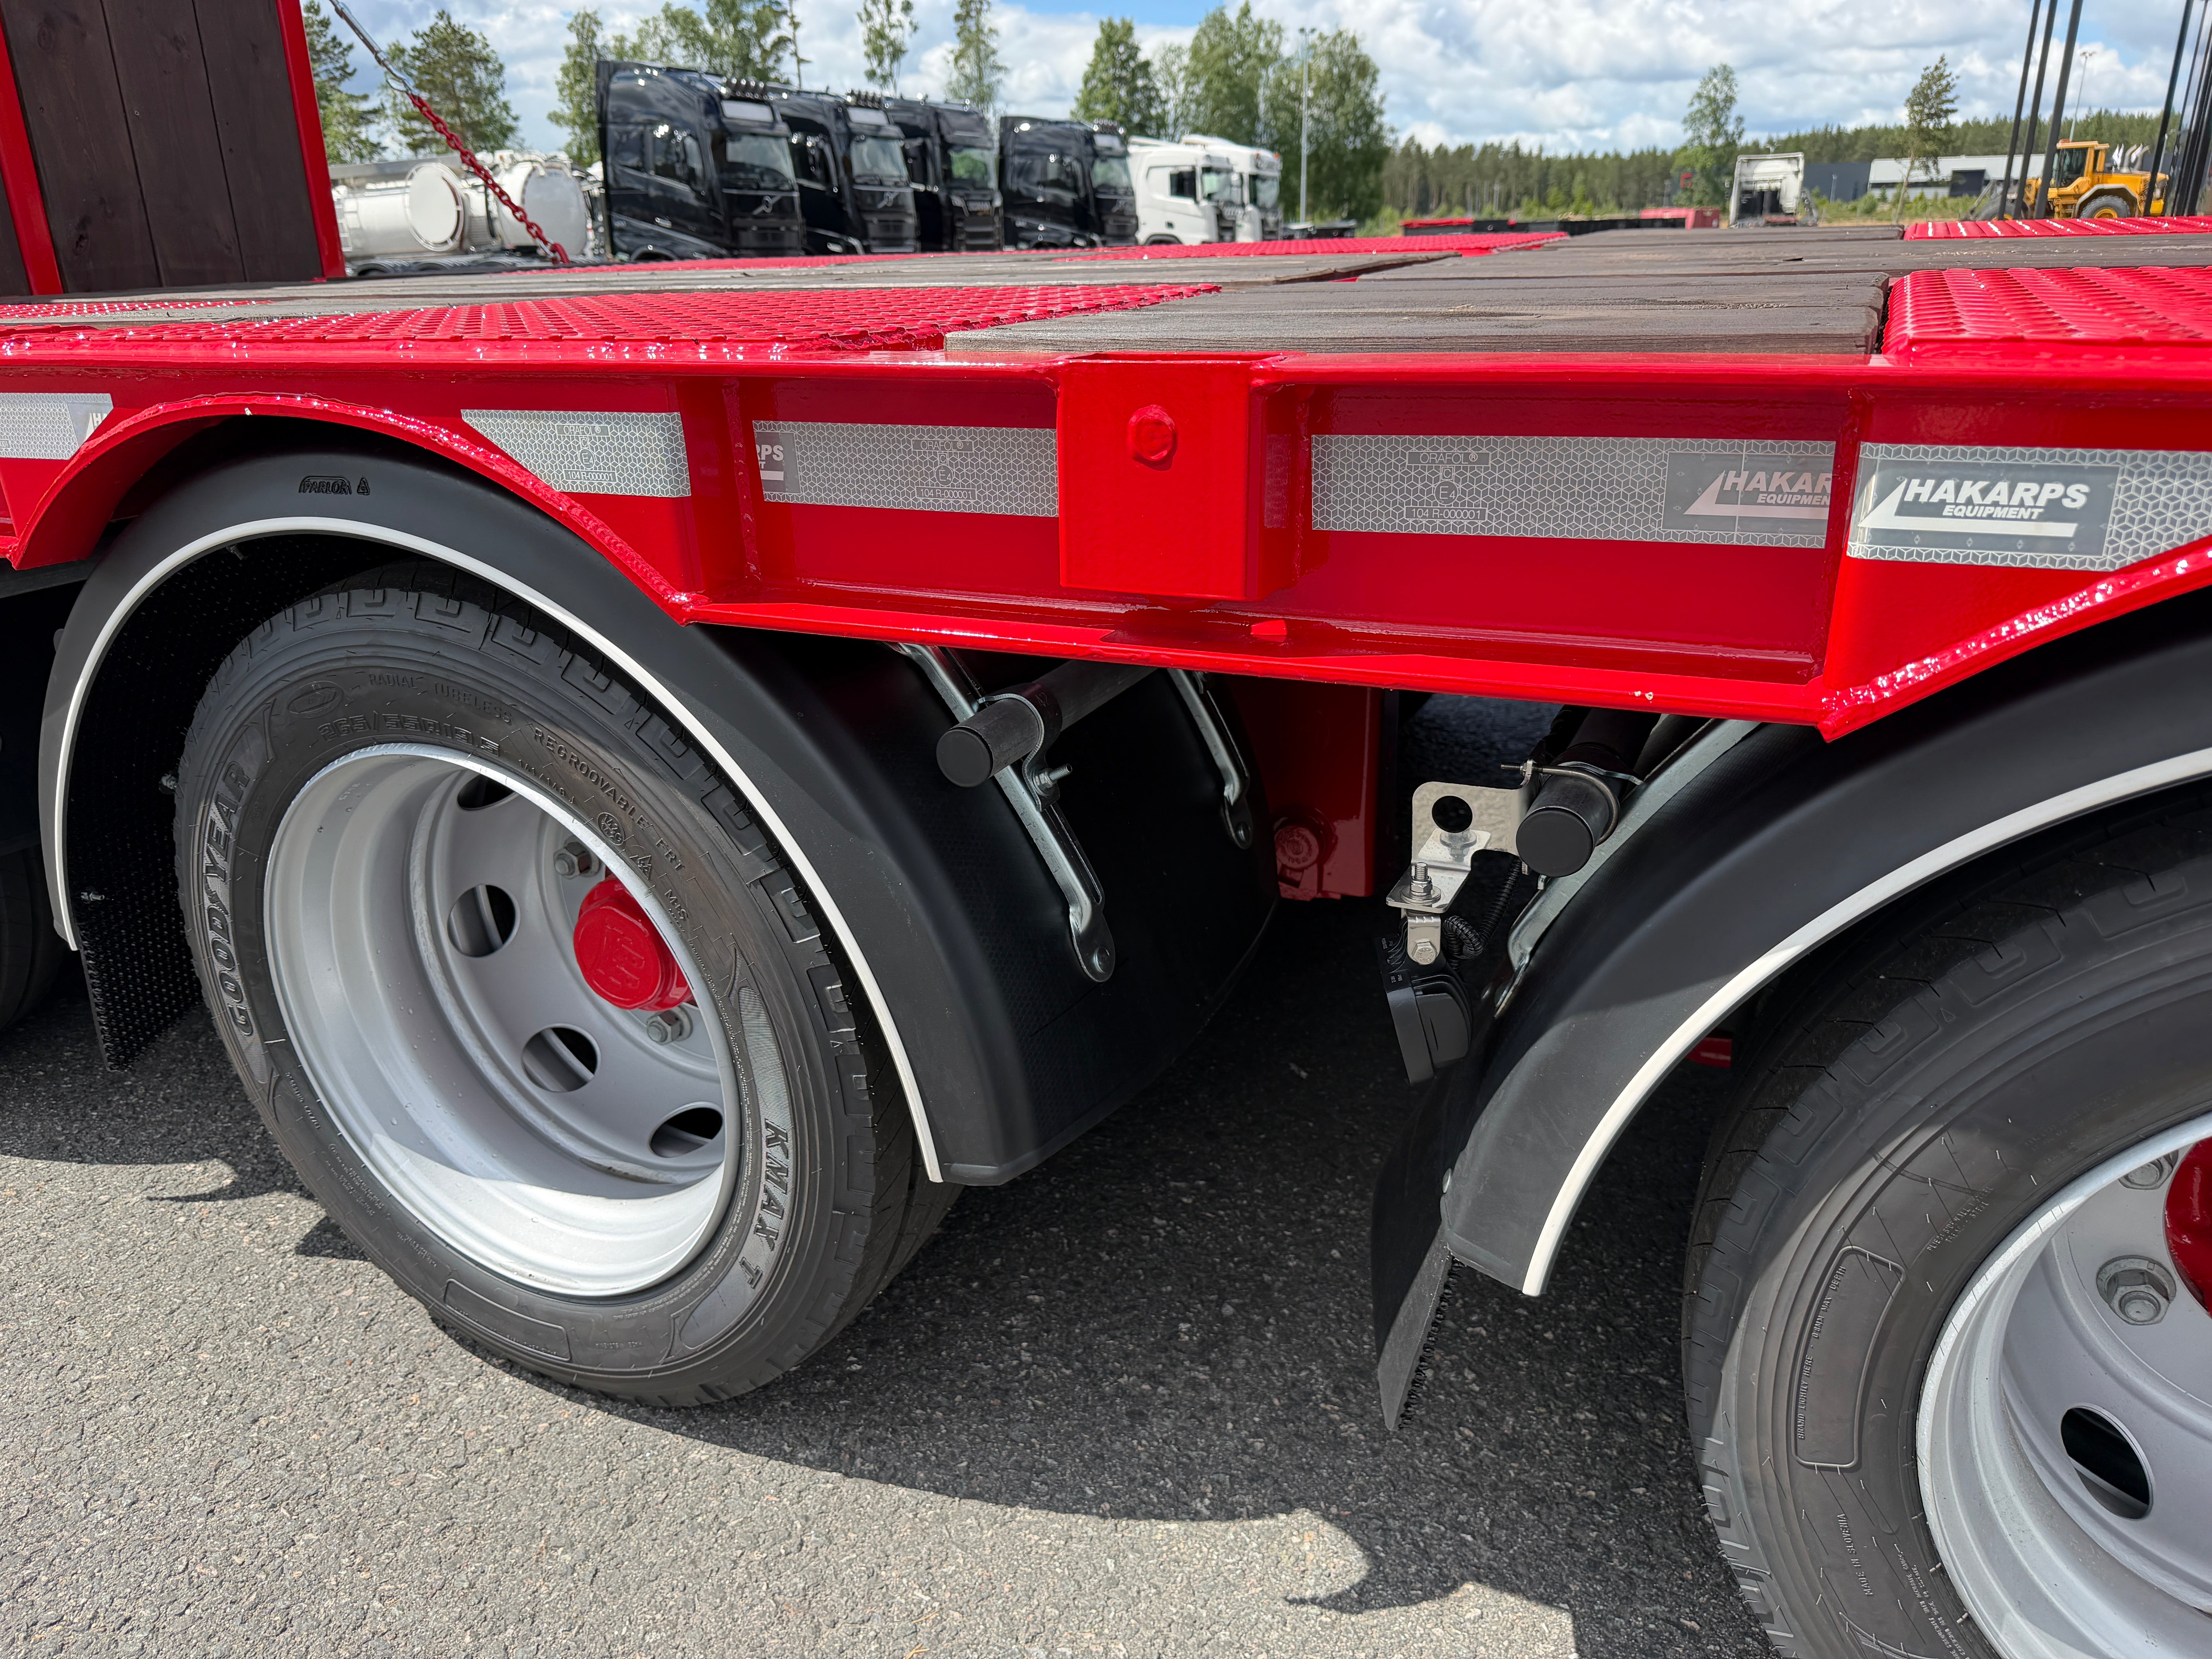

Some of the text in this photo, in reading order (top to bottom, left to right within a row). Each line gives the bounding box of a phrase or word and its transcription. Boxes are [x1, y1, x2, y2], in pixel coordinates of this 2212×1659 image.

[567, 471, 613, 482] 104 R-000001
[920, 488, 972, 500] 104 R-000001
[1904, 478, 2090, 509] HAKARPS
[1412, 508, 1481, 520] 104 R-000001
[1942, 505, 2045, 520] EQUIPMENT
[368, 674, 512, 723] RADIAL TUBELESS
[534, 727, 685, 871] REGROOVABLE FRT
[754, 1119, 788, 1251] KMAX
[1798, 1413, 1806, 1439] BRAND
[1803, 1355, 1813, 1377] HERE
